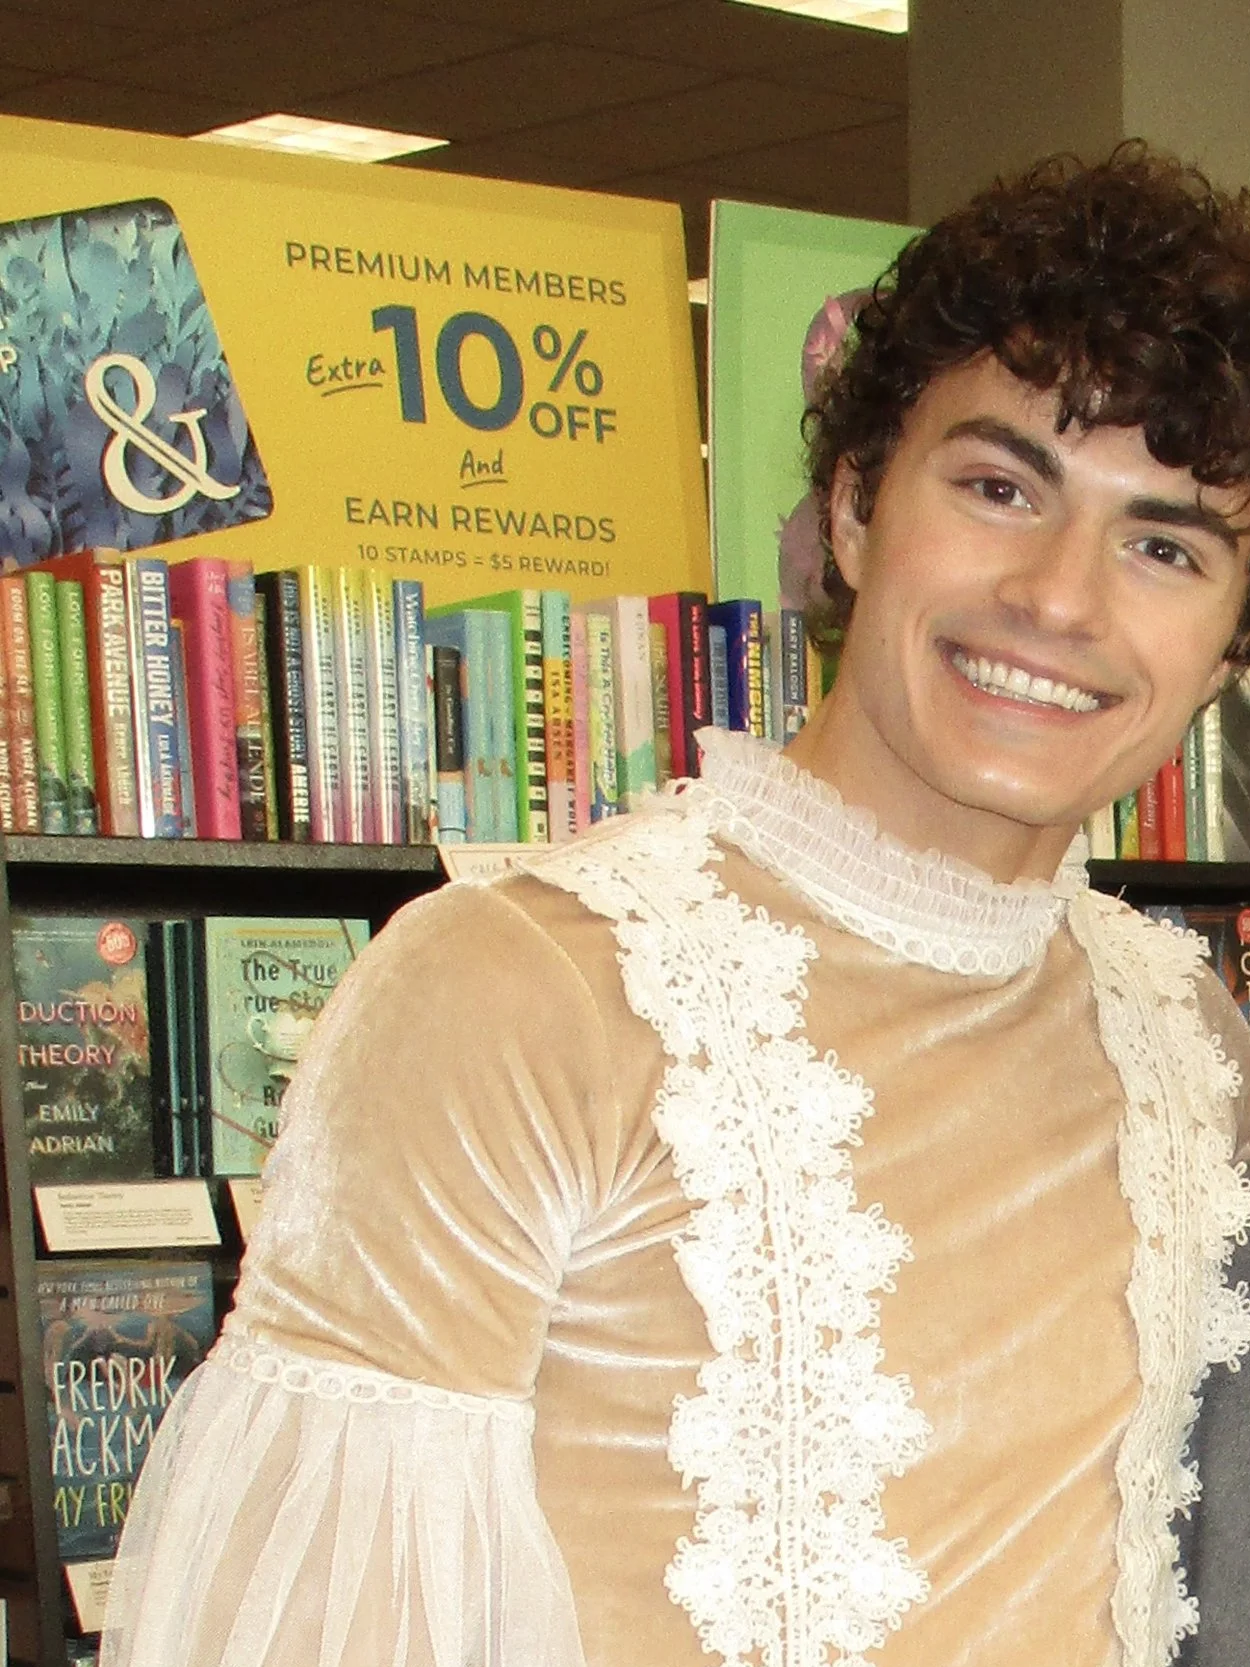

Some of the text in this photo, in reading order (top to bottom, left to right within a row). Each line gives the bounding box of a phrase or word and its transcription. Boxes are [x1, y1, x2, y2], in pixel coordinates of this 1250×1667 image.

[287, 242, 626, 305] PREMIUM MEMBERS
[307, 353, 386, 386] Extra
[529, 401, 618, 443] OFF
[459, 449, 504, 480] And
[345, 497, 617, 543] EARN REWARDS
[358, 543, 378, 562] 10
[384, 545, 468, 568] STAMPS
[490, 552, 513, 572] $5
[518, 554, 611, 576] REWARD!
[100, 569, 124, 628] PARK
[140, 571, 173, 727] BITTER HONEY
[404, 593, 420, 666] Watching
[104, 633, 130, 717] AVENUE
[241, 627, 259, 694] ISABEL
[562, 615, 572, 704] UNBECOMING
[600, 647, 611, 674] This
[747, 612, 763, 736] THE NIMBUS
[789, 616, 799, 700] MARY BALOGH
[600, 693, 612, 715] Cry
[601, 679, 611, 690] A
[245, 705, 265, 804] ALLENDE
[565, 719, 576, 792] MARGARET
[291, 764, 309, 823] AMERIE
[241, 958, 338, 982] The True
[18, 1001, 137, 1024] DUCTION
[18, 1044, 116, 1067] THEORY
[39, 1105, 99, 1123] EMILY
[30, 1136, 114, 1154] ADRIAN
[52, 1354, 178, 1415] FREDRIK
